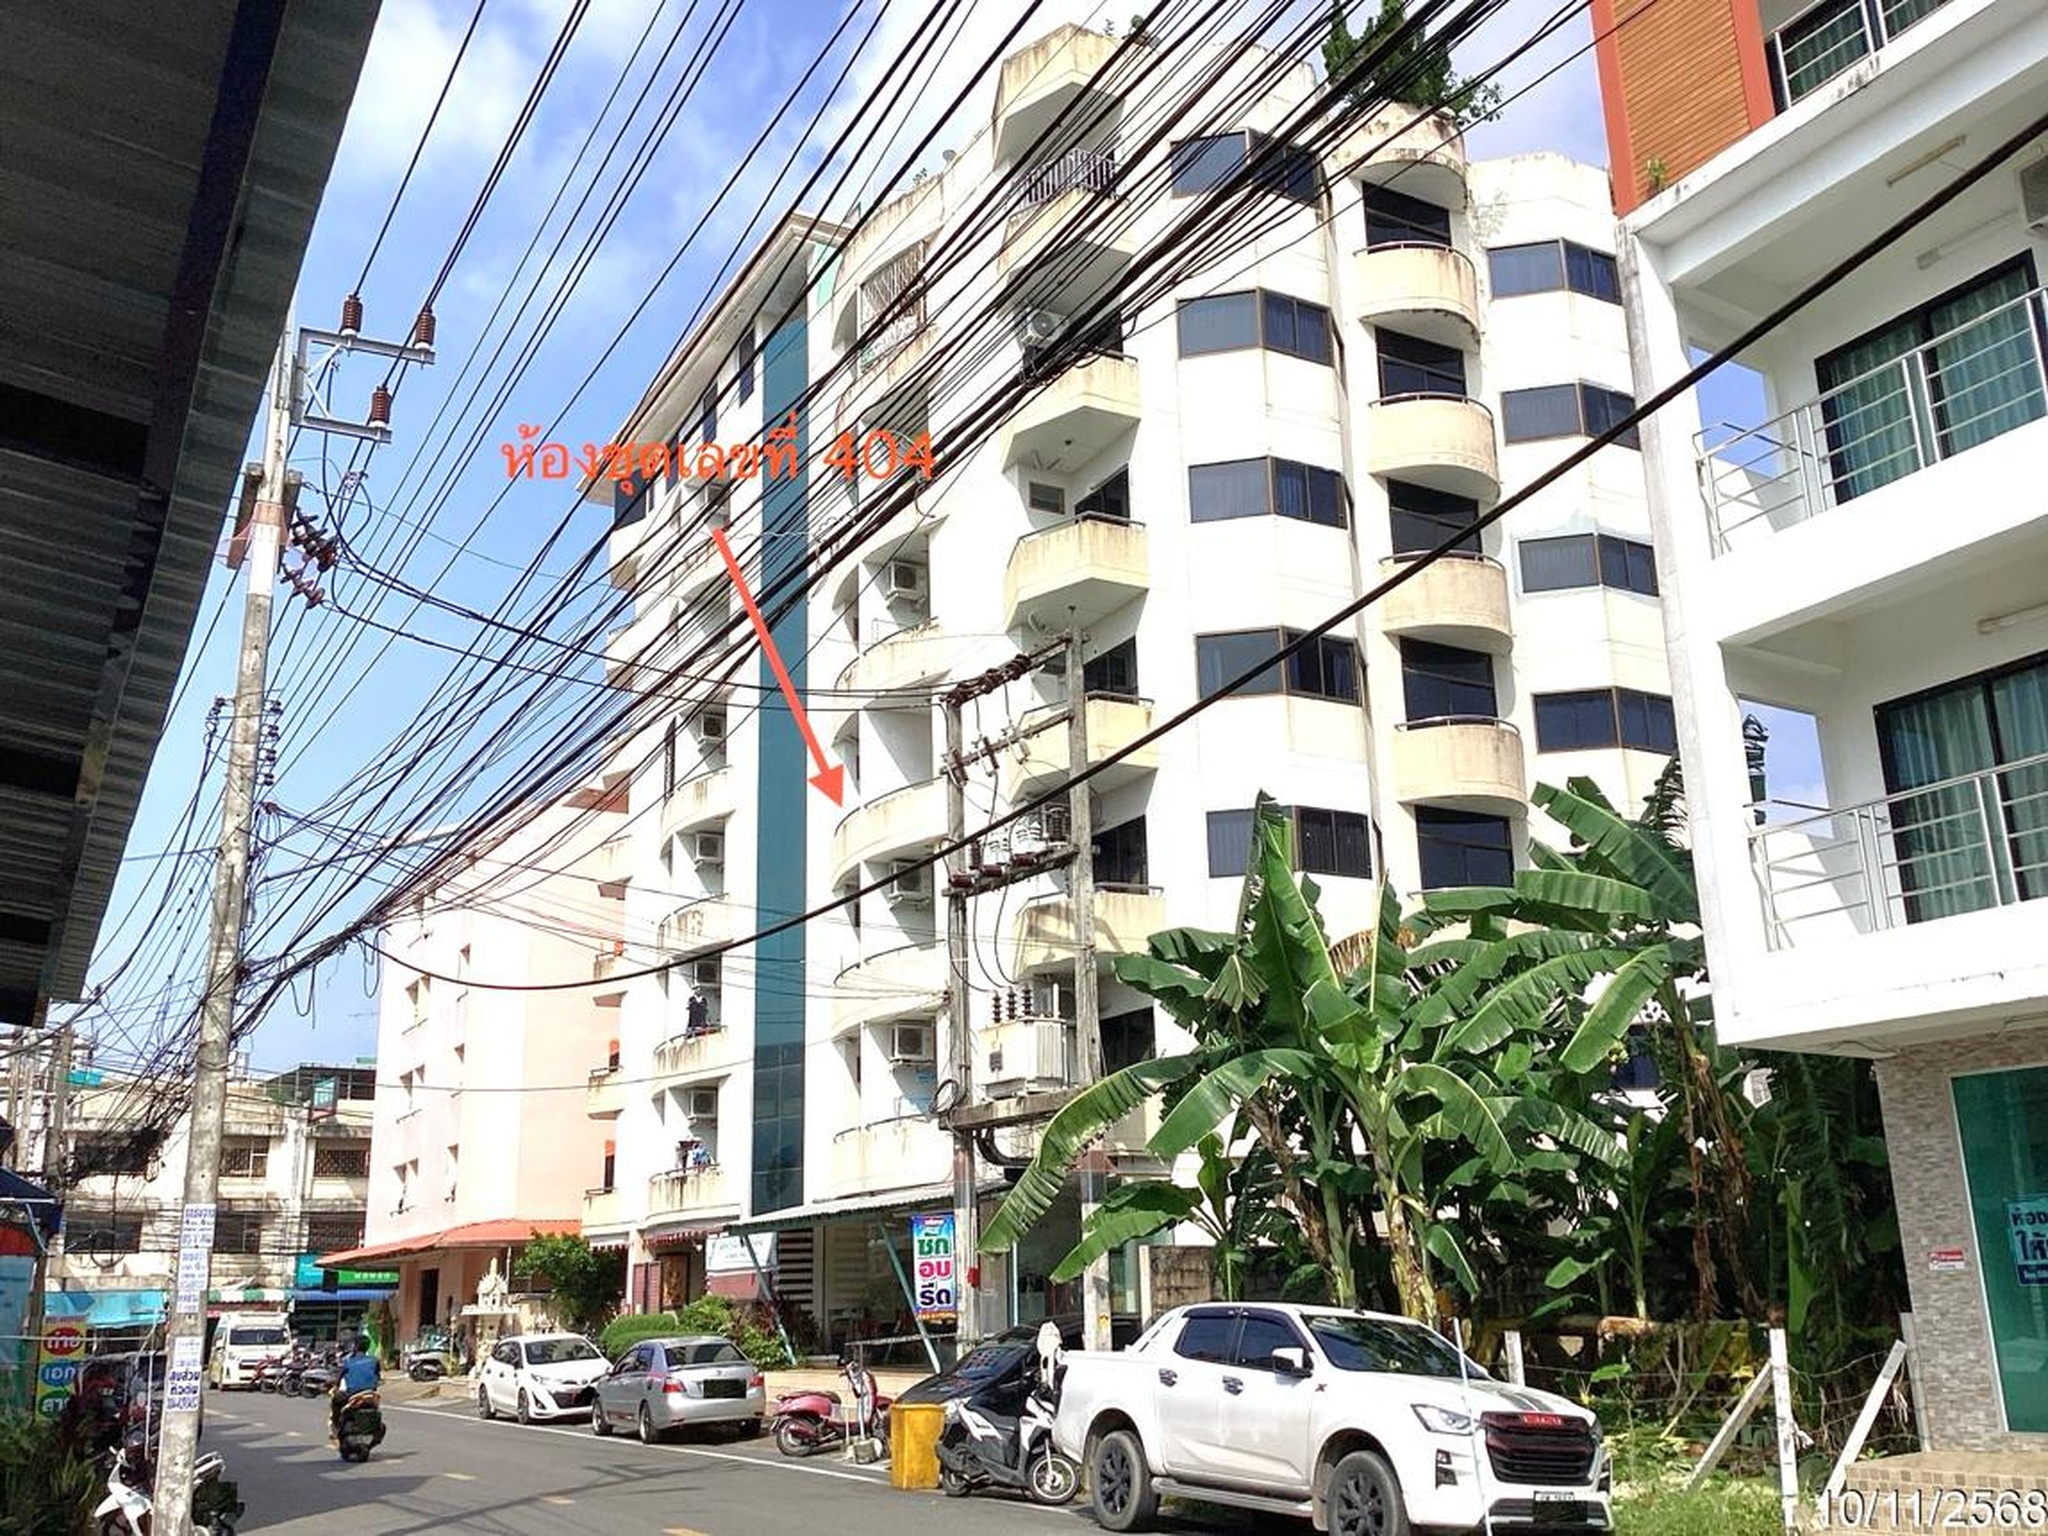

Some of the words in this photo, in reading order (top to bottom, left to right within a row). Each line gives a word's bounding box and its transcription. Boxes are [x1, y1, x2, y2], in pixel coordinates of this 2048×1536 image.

[917, 1232, 950, 1257] ชัก
[919, 1260, 952, 1278] อบ
[920, 1281, 951, 1306] รีด
